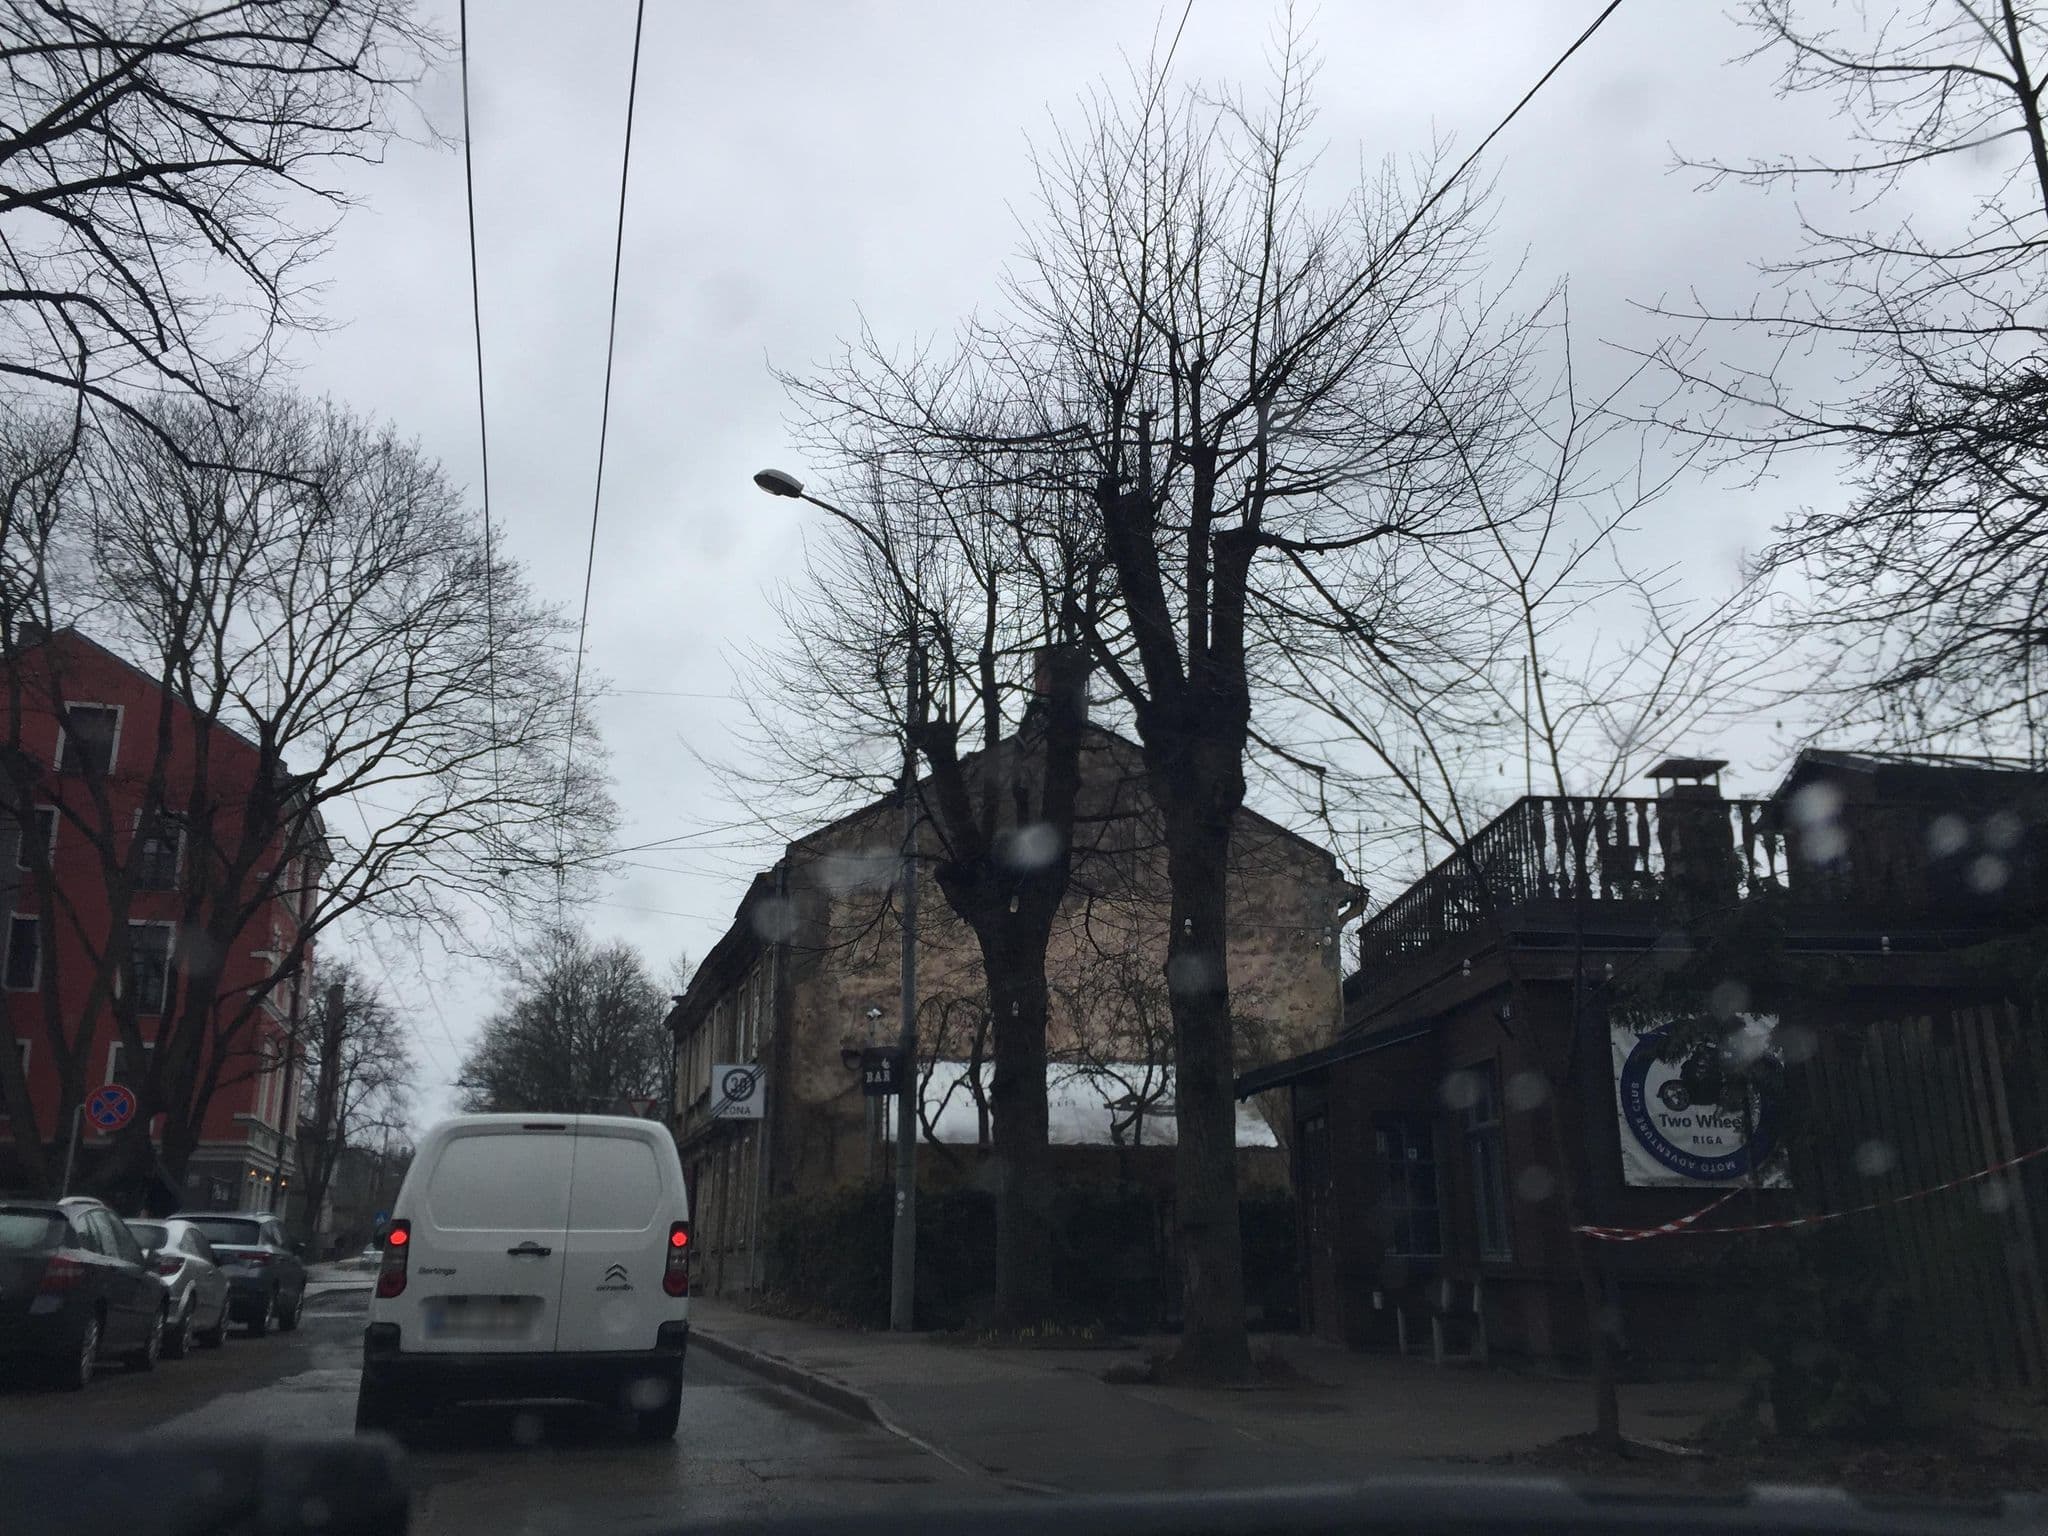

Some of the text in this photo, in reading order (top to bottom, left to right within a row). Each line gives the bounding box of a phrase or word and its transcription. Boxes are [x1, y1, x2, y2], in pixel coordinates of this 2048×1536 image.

[1659, 1114, 1692, 1127] Two
[1631, 1082, 1736, 1173] MOTO ADVENTURE CLUB
[1693, 1136, 1722, 1145] RIGA
